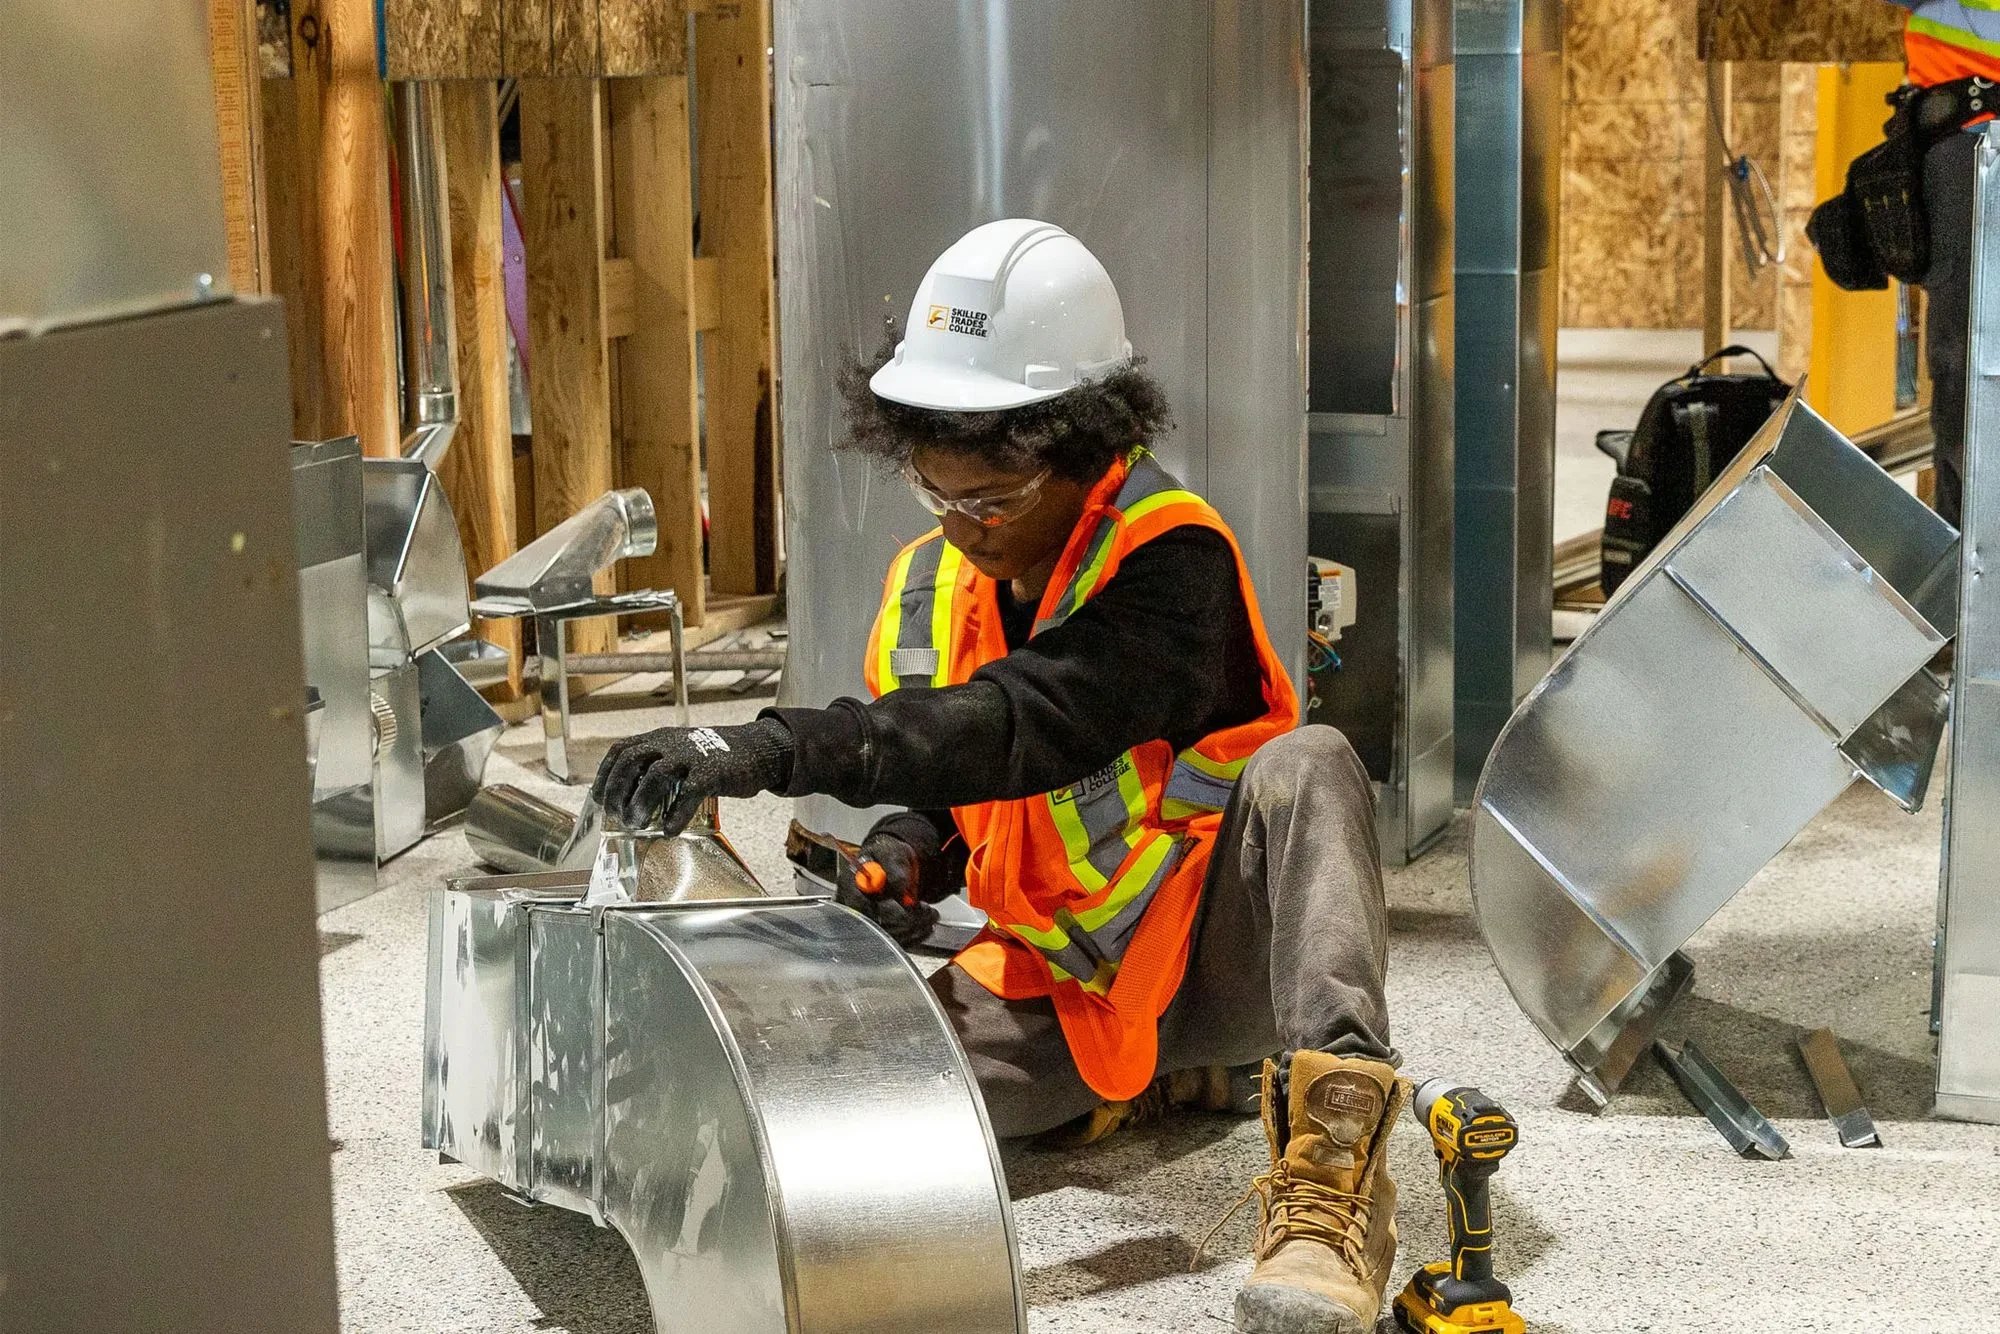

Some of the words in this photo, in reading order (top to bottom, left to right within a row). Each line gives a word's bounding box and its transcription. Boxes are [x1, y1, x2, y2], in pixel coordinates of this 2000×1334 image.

[951, 308, 987, 321] SKILLED
[950, 316, 984, 329] TRADES
[949, 324, 987, 337] COLLEGE
[1089, 763, 1131, 791] COLLEGE
